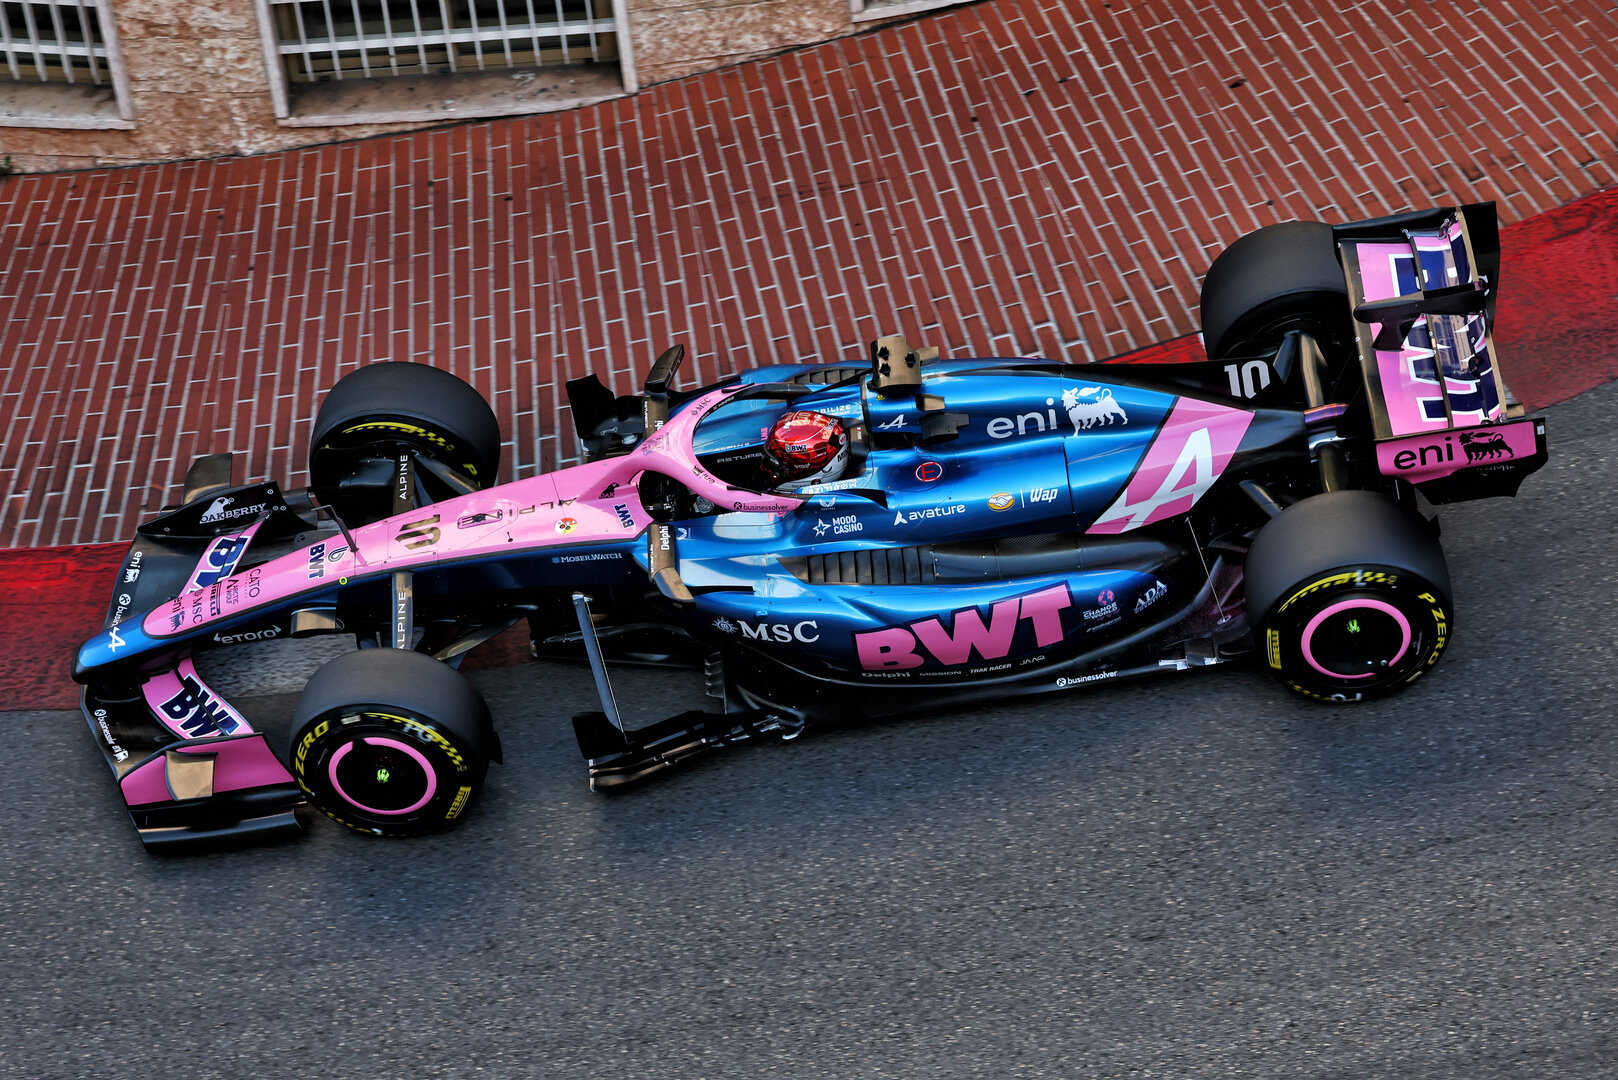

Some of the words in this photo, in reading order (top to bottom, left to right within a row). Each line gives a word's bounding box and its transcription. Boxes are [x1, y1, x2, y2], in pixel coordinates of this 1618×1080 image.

[1224, 360, 1271, 399] 10
[986, 397, 1058, 439] eni
[1393, 436, 1455, 470] eni
[399, 454, 409, 500] ALPINE
[743, 503, 789, 512] businessolver
[1029, 488, 1059, 504] Wap
[200, 502, 267, 523] OAKBERRY
[613, 503, 635, 529] BWT
[832, 514, 857, 527] MODO
[908, 503, 966, 521] avature
[394, 513, 442, 551] 10
[660, 525, 669, 551] Delphi
[833, 522, 863, 535] CASINO
[129, 551, 143, 569] eni
[308, 542, 326, 580] BWT
[248, 568, 261, 598] CATO
[1134, 579, 1168, 609] ADA
[191, 596, 204, 624] MSC
[398, 591, 408, 650] ALPINE
[221, 629, 276, 644] etoro
[736, 620, 820, 643] MSC
[855, 583, 1073, 671] BWT
[1418, 592, 1436, 604] P
[1427, 607, 1448, 665] ZERO
[988, 663, 1013, 672] RACER
[1067, 671, 1118, 685] businessolver
[295, 720, 331, 777] ZERO
[444, 786, 472, 820] PIRELLI
